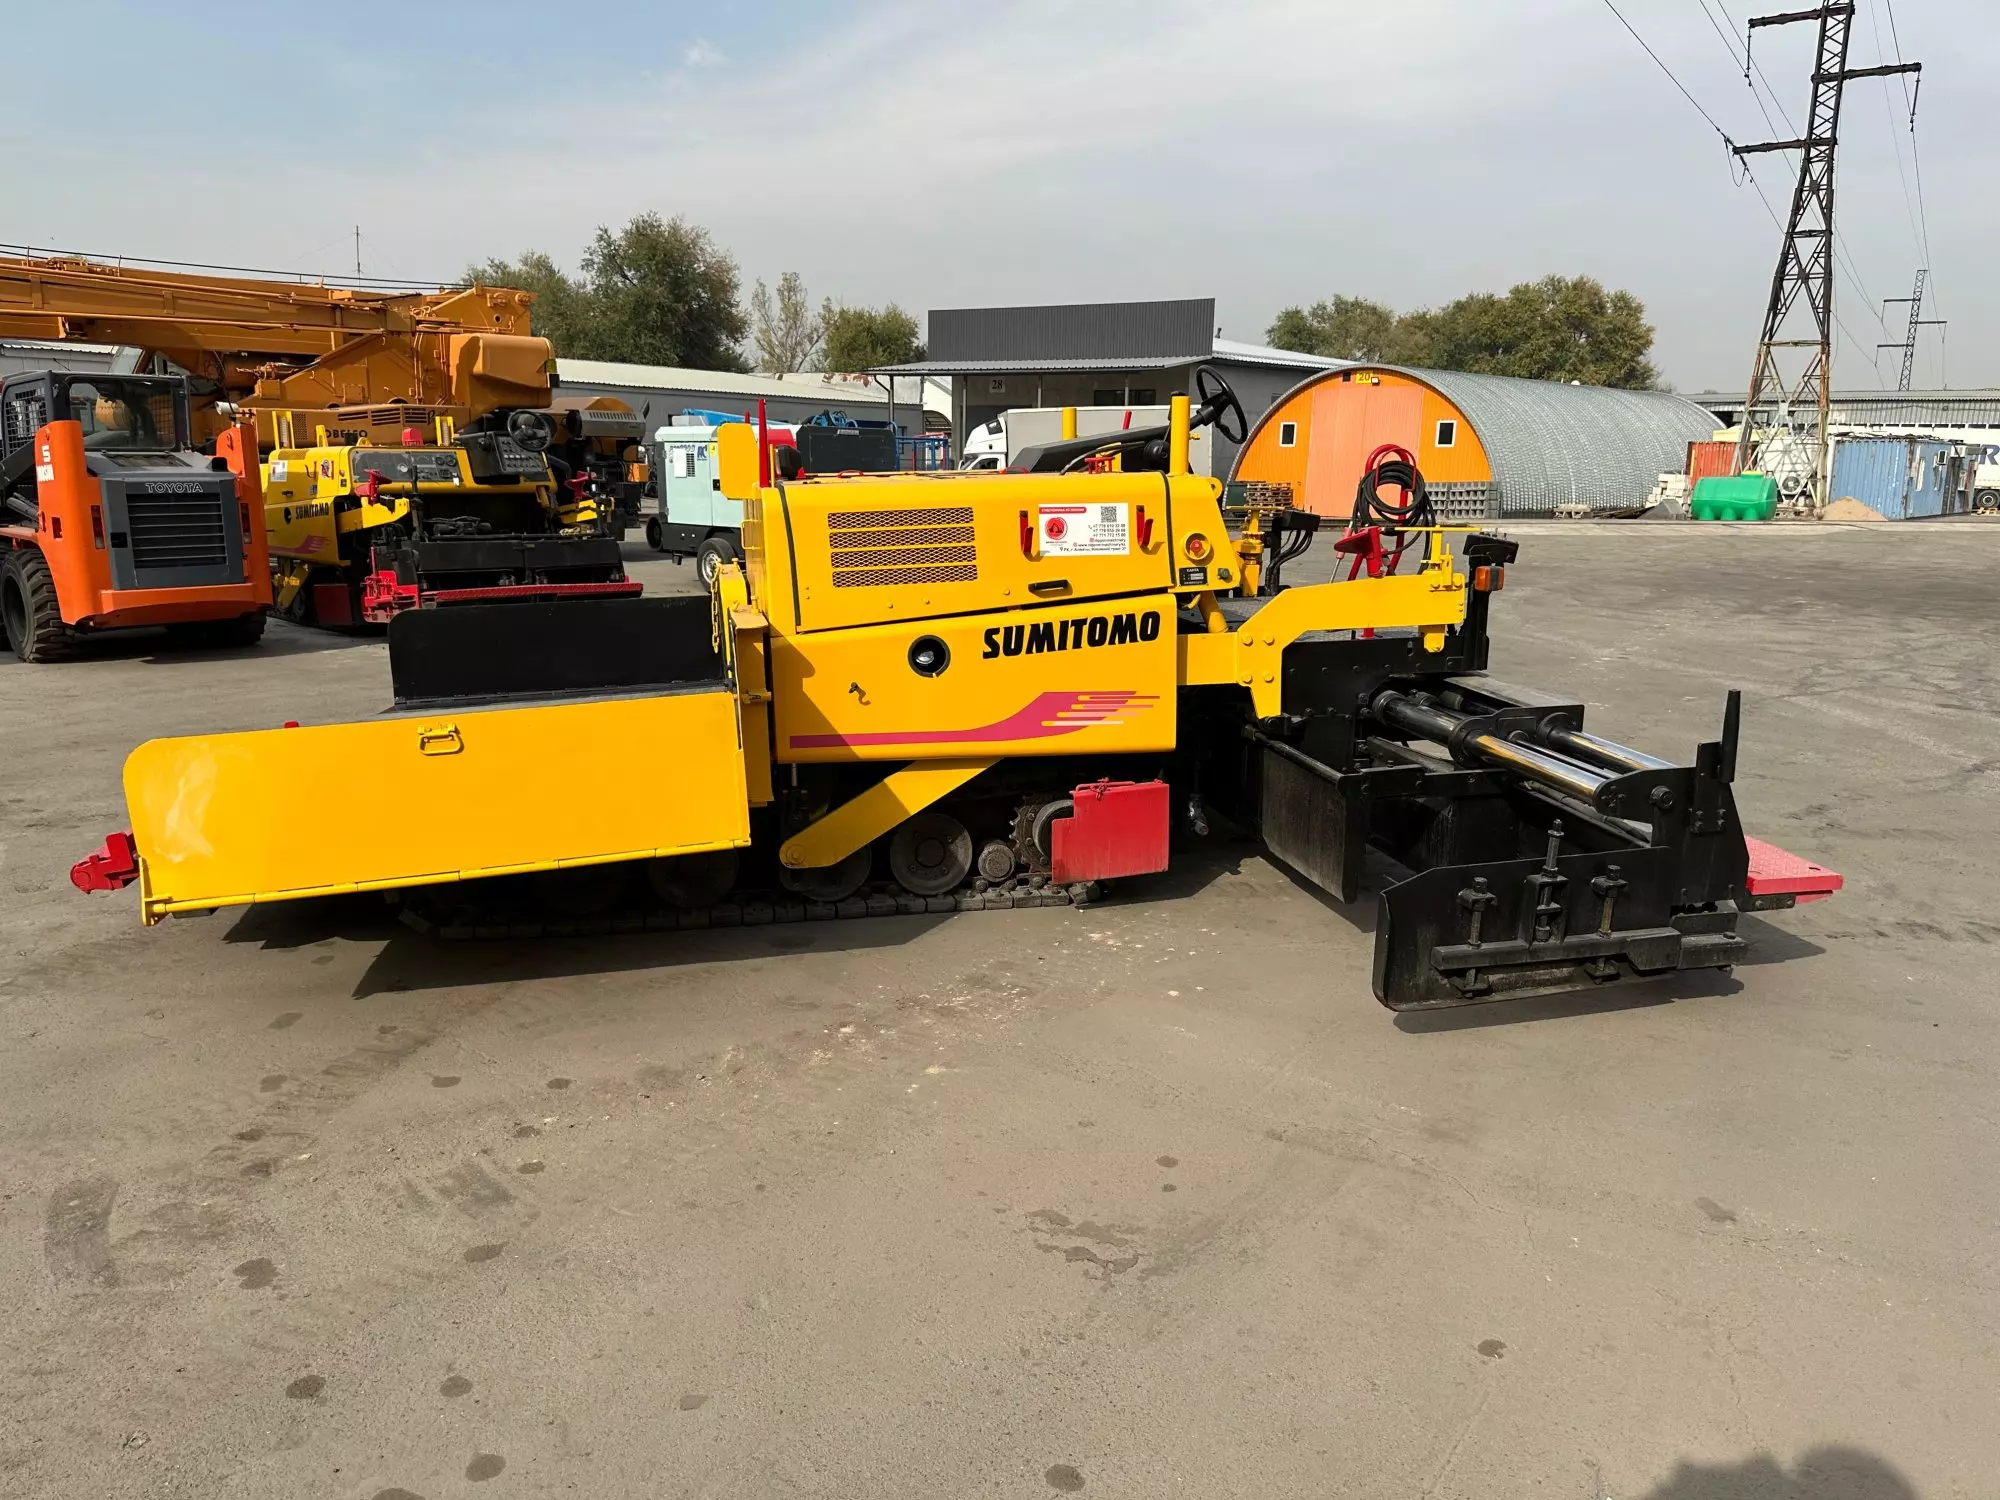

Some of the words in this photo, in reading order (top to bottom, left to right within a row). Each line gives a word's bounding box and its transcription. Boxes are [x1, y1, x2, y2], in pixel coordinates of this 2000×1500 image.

[992, 379, 1003, 390] 28
[145, 482, 204, 494] TOYOTA
[295, 502, 330, 520] SUMITOMO
[983, 611, 1161, 659] SUMITOMO
